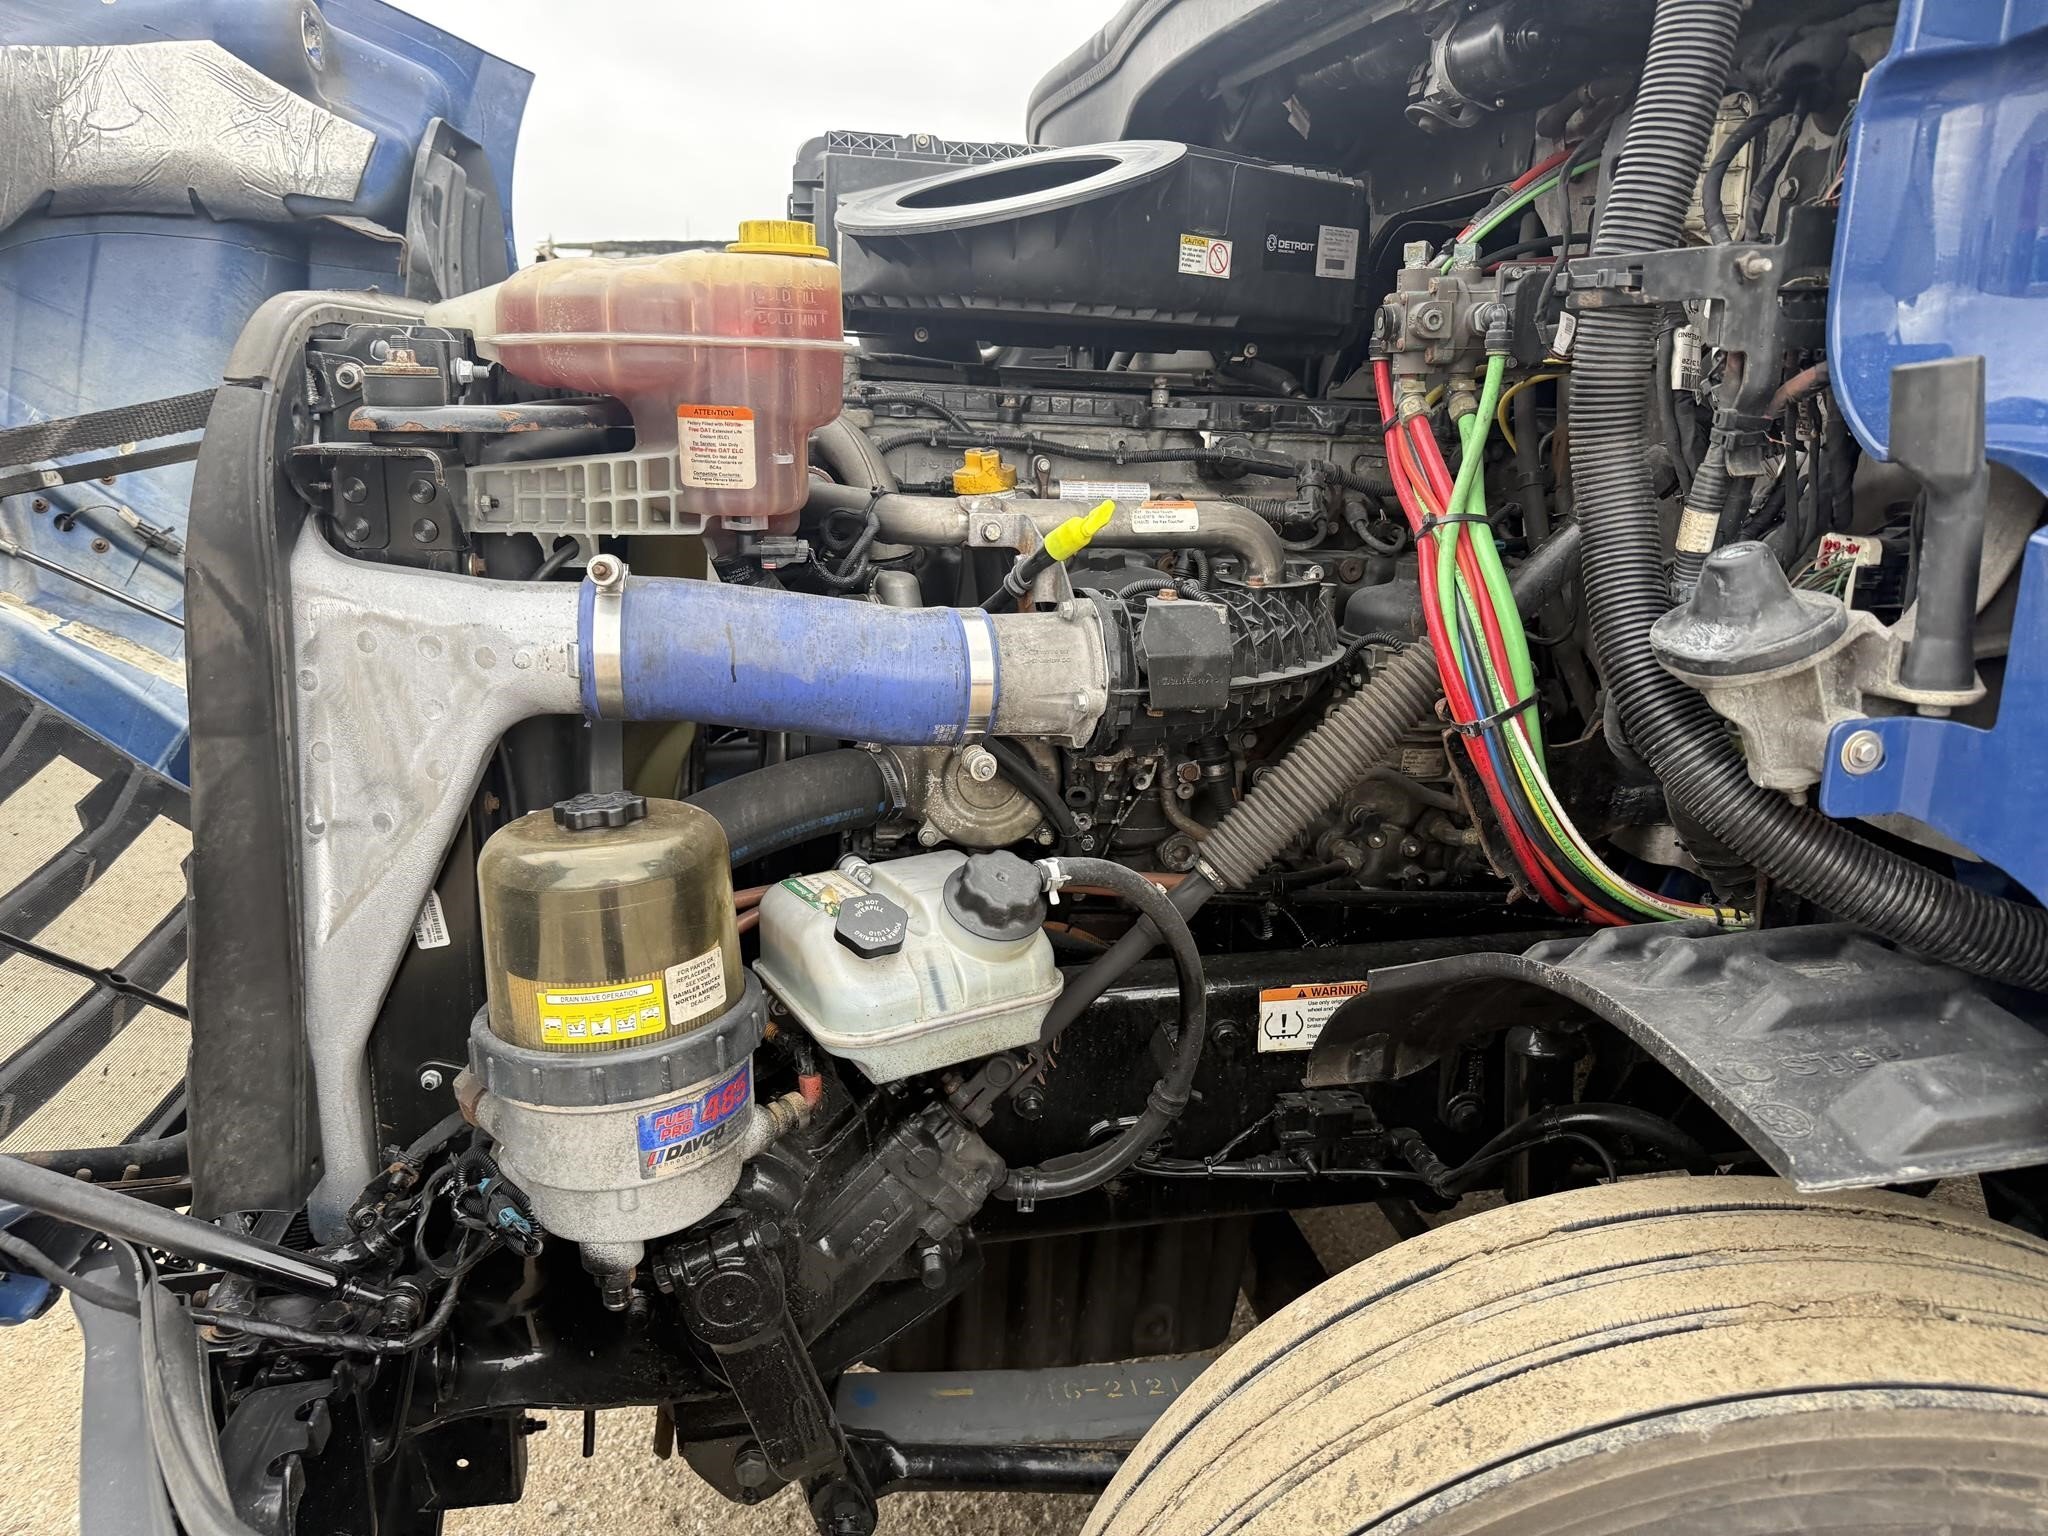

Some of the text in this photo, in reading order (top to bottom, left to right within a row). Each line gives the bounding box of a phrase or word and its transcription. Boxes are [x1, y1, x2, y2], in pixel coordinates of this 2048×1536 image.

[1184, 237, 1206, 245] CAUTION
[1278, 240, 1316, 252] DETROIT
[796, 291, 817, 305] FILL
[758, 312, 818, 328] COLD MIN
[693, 408, 735, 417] ATTENTION
[855, 905, 884, 918] OVERFILL
[854, 930, 887, 942] STEERING
[868, 927, 891, 937] FLUID
[886, 922, 902, 939] POWER
[676, 963, 716, 984] REPLACEMENTS
[677, 956, 714, 976] FOR PARTS OR
[697, 972, 711, 982] YOUR
[601, 989, 638, 1000] OPERATION
[673, 974, 721, 1000] DAIMLER TRUCKS
[675, 993, 697, 1006] NORTH
[698, 982, 721, 997] AMERICA
[1311, 985, 1368, 996] WARNING
[690, 994, 711, 1007] DEALER
[1777, 1046, 1905, 1076] STEP
[700, 1072, 748, 1124] 485
[655, 1107, 694, 1129] FUEL
[660, 1120, 695, 1142] PRO
[665, 1122, 727, 1162] DAVCO
[1048, 1375, 1194, 1400] 16-2121
